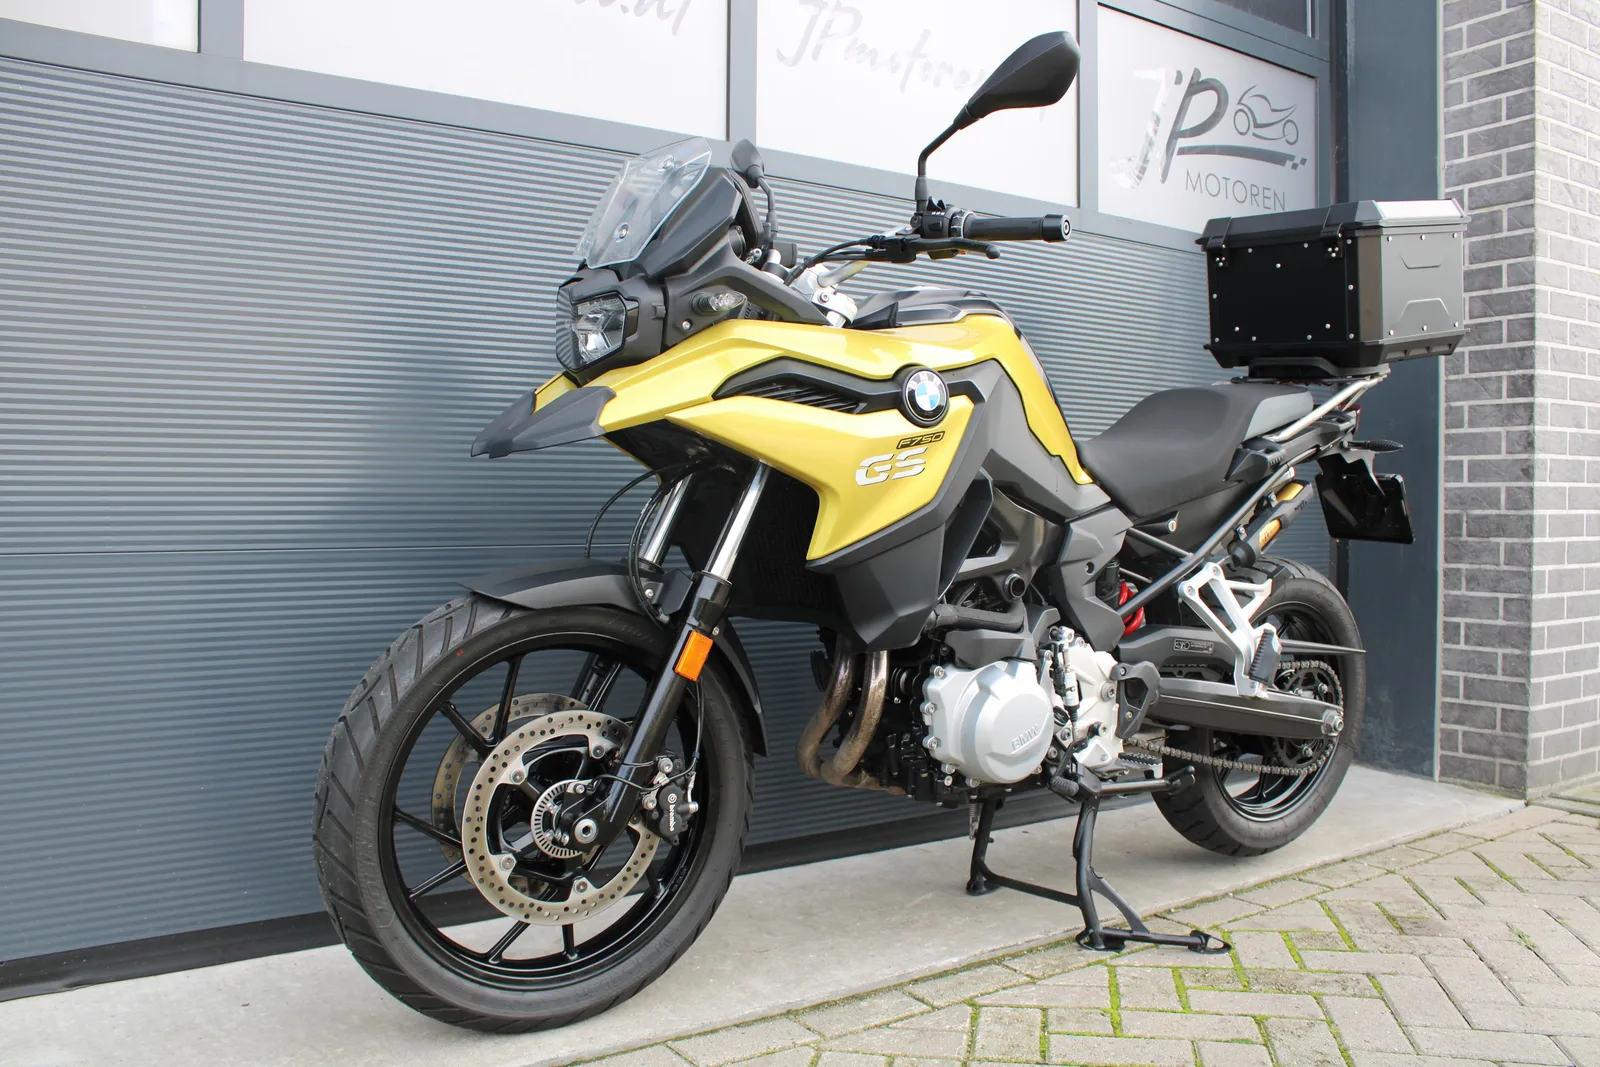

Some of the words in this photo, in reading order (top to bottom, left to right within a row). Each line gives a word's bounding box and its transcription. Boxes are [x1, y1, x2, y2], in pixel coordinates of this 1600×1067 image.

[1185, 168, 1285, 211] MOTOREN
[898, 432, 943, 449] F750
[855, 446, 928, 486] GS
[1012, 724, 1038, 749] BMW
